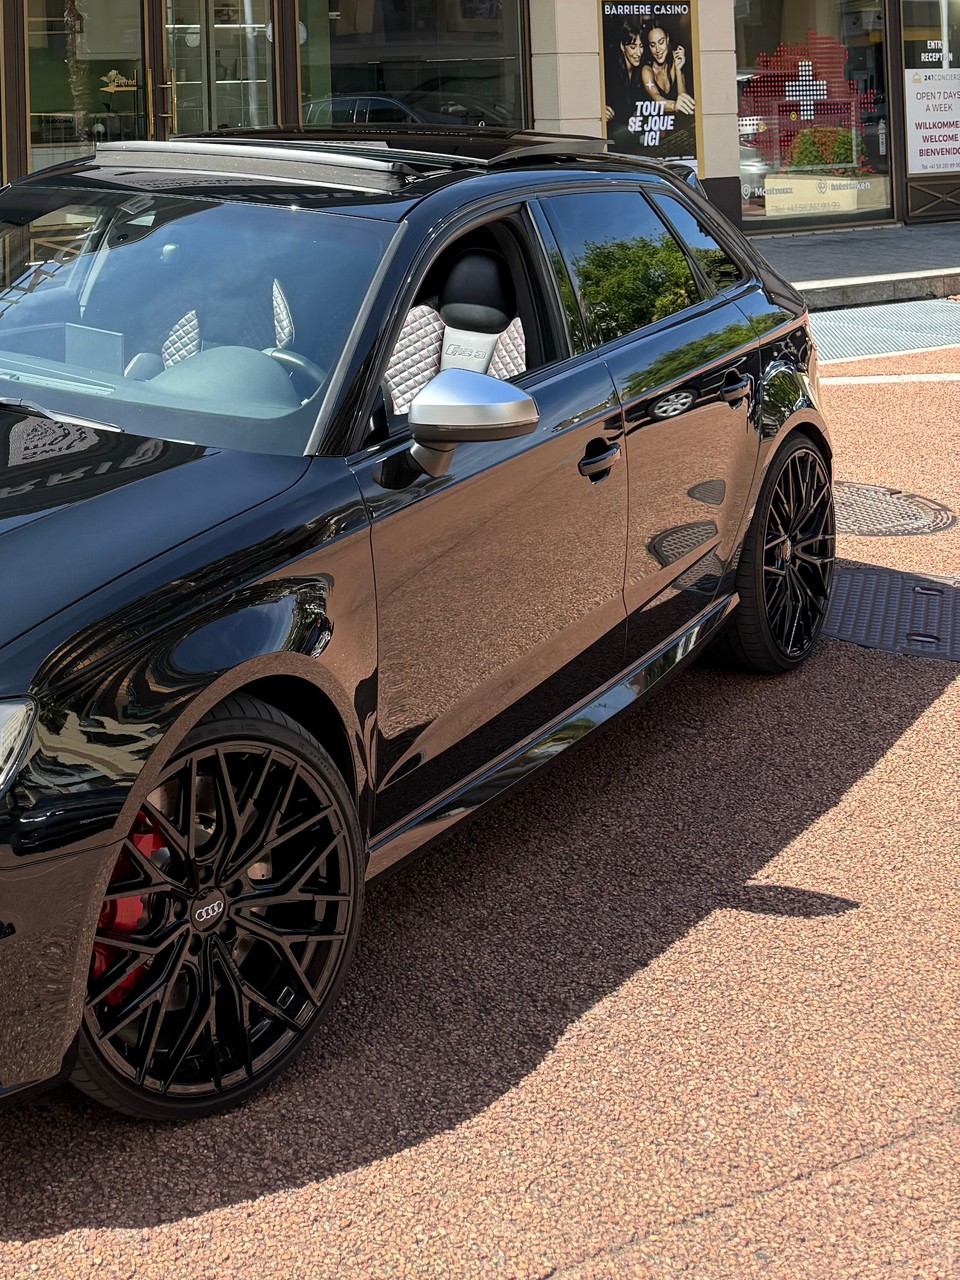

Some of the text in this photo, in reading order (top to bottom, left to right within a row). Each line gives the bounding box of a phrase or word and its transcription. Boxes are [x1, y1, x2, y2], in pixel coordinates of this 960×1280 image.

[653, 4, 689, 15] CASINO
[921, 52, 953, 62] RECEPTN
[916, 91, 960, 100] OPEN 7 DAYS
[635, 101, 666, 117] TOUT
[925, 103, 953, 112] A WEEK
[628, 115, 675, 132] SE JOUE
[643, 131, 660, 147] ICI
[922, 134, 959, 143] WELCOME
